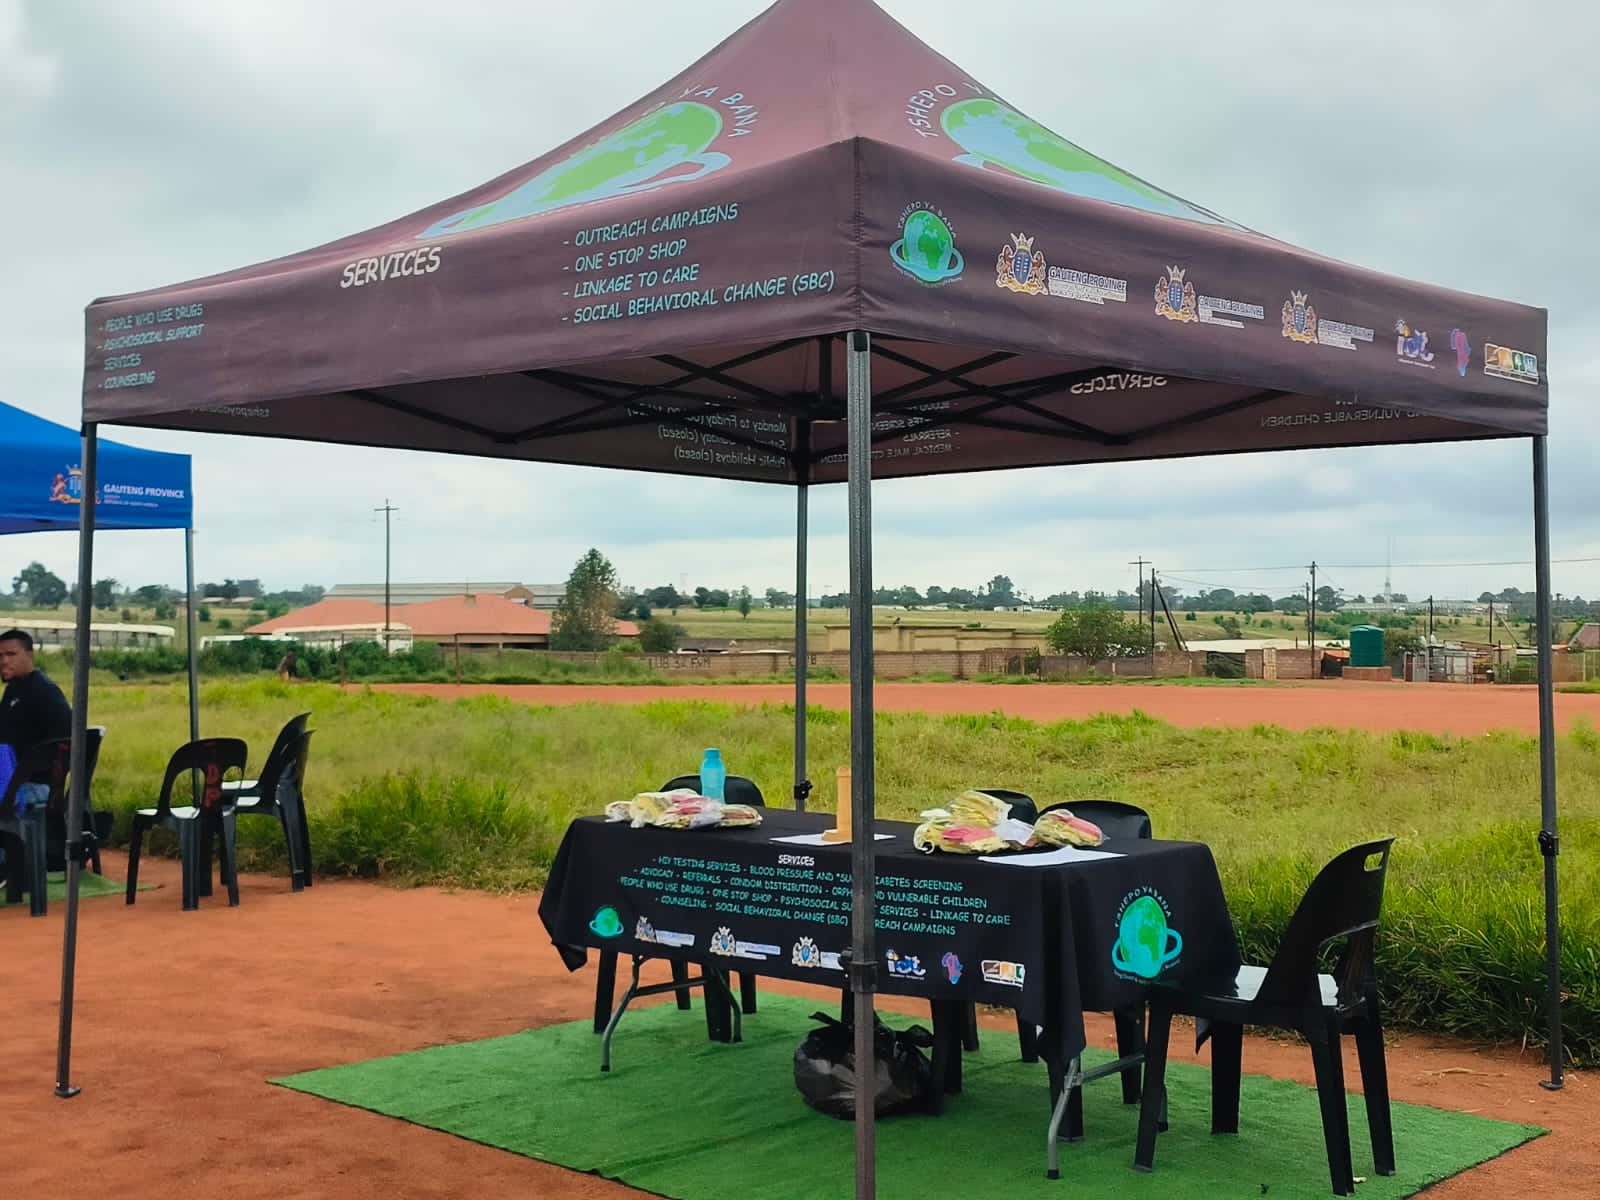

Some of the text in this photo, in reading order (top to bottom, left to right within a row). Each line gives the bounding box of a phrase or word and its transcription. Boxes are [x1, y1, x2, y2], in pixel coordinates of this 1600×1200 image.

[720, 92, 758, 137] BANA
[905, 84, 957, 137] TSHEPO
[575, 219, 648, 247] OUTREACH
[651, 203, 739, 233] CAMPAIGNS
[340, 246, 442, 289] SERVICES
[575, 253, 603, 273] ONE
[608, 247, 644, 268] STOP
[649, 239, 687, 260] SHOP
[574, 273, 633, 298] LINKAGE
[638, 270, 658, 287] TO
[662, 264, 700, 285] CARE
[1049, 266, 1088, 285] GAUTENG
[157, 308, 174, 323] USE
[175, 304, 204, 319] DRUGS
[574, 301, 623, 324] SOCIAL
[628, 288, 718, 316] BEHAVIORAL
[723, 276, 787, 303] CHANGE
[791, 270, 835, 296] (SBC)
[166, 323, 205, 341] SUPPORT
[104, 484, 184, 498] GAUTENG PROVINCE
[673, 857, 704, 868] TESTING
[706, 861, 741, 873] SERVICES
[750, 865, 775, 876] BLOOD
[777, 868, 814, 879] PRESSURE
[816, 872, 833, 880] AND
[875, 876, 910, 887] IABETES
[913, 880, 963, 891] SCREENING
[778, 854, 815, 866] SERVICES
[620, 876, 645, 888] PEOPLE
[647, 880, 664, 890] WHO
[665, 883, 678, 893] USE
[681, 884, 704, 895] DRUGS
[712, 888, 729, 897] ONE
[731, 890, 750, 900] STOP
[752, 892, 772, 903] SHOP
[780, 895, 839, 910] PSYCHOSOCIAL
[880, 905, 919, 918] SERVICES
[930, 910, 969, 922] LINKAGE
[972, 913, 984, 923] TO
[985, 914, 1011, 925] CARE
[641, 867, 673, 878] ADVOCACY
[683, 872, 721, 884] REFERRALS
[730, 877, 762, 888] CONDOM
[765, 881, 822, 894] DISTRIBUTION
[887, 891, 939, 905] VULNERABLE
[942, 897, 987, 909] CHILDREN
[661, 895, 707, 908] COUNSELING
[715, 903, 741, 914] SOCIAL
[744, 905, 791, 919] BEHAVIORAL
[794, 911, 825, 923] CHANGE
[827, 914, 849, 927] (SBC)
[902, 922, 956, 935] CAMPAIGNS
